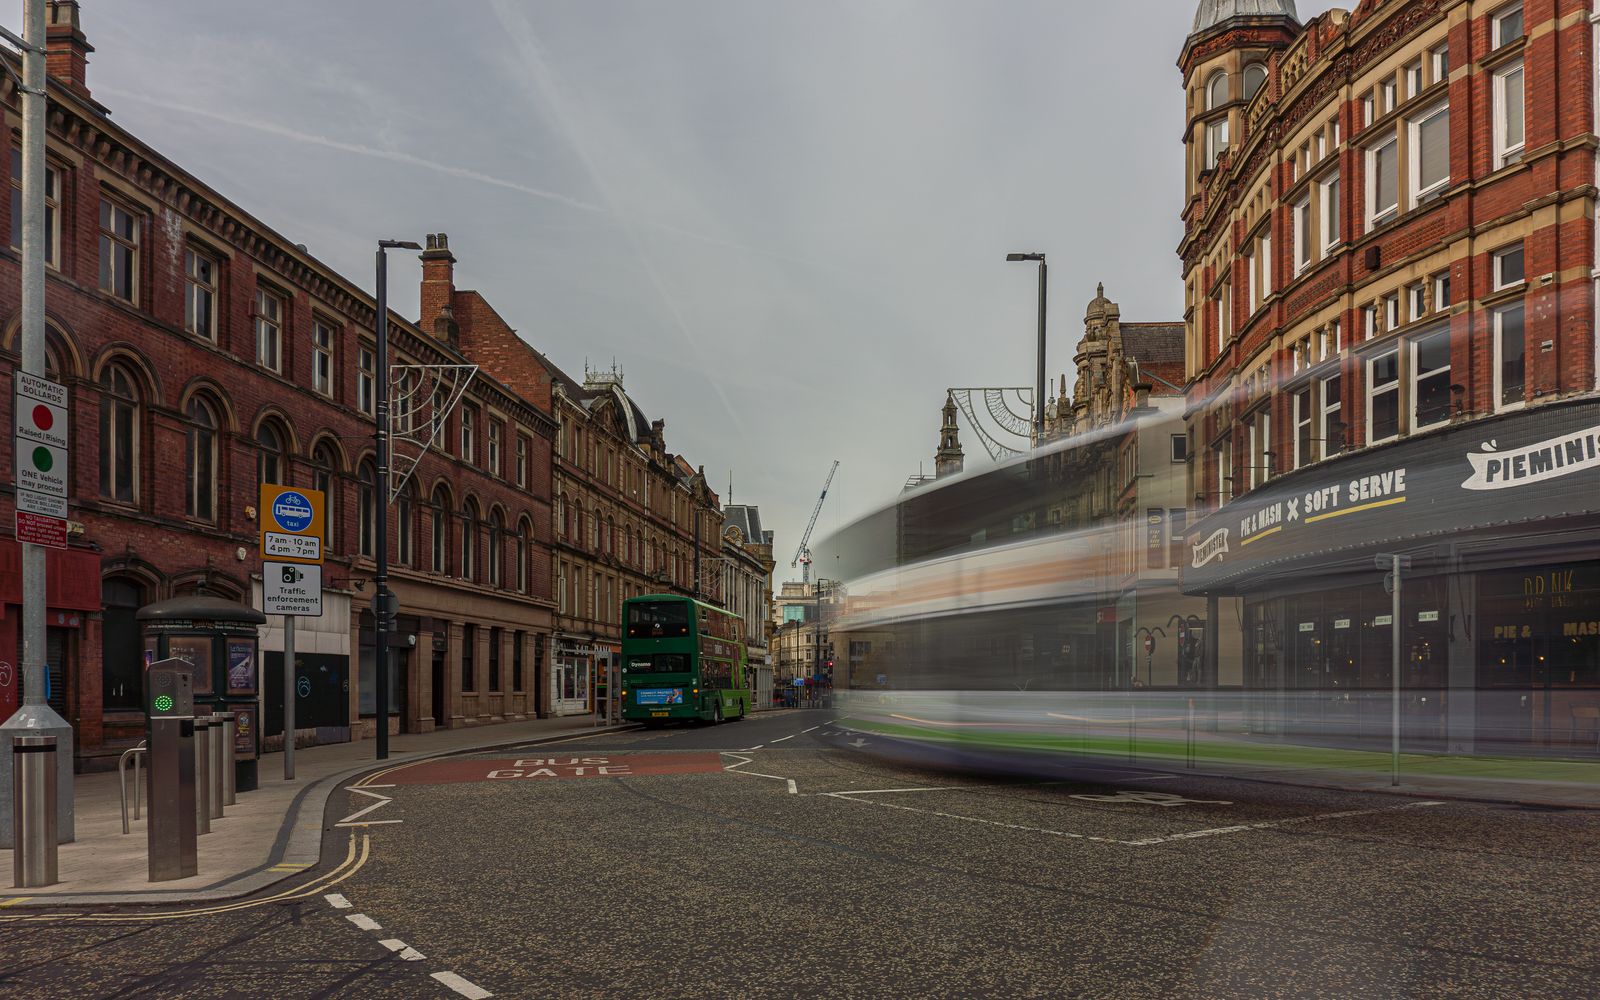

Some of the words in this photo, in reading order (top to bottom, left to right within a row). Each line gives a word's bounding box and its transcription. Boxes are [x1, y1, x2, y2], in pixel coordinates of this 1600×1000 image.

[21, 376, 64, 396] AUTOMATIC
[23, 385, 62, 404] BOLLARDS
[1486, 434, 1600, 483] PIEMINI
[21, 469, 38, 479] ONE
[40, 473, 63, 485] Vehicle
[21, 479, 36, 489] may
[37, 483, 64, 494] proceed
[39, 501, 63, 510] BOLLARDS
[1240, 517, 1251, 537] PIE
[1251, 514, 1257, 532] &
[1258, 502, 1282, 531] MASH
[1304, 484, 1340, 514] SOFT
[1349, 468, 1406, 503] SERVE
[268, 535, 274, 543] 7
[279, 586, 306, 595] Traffic
[267, 595, 319, 604] enforcement
[1494, 625, 1517, 639] PIE
[1521, 624, 1532, 638] &
[513, 757, 609, 767] BUS
[486, 765, 633, 779] GATE
